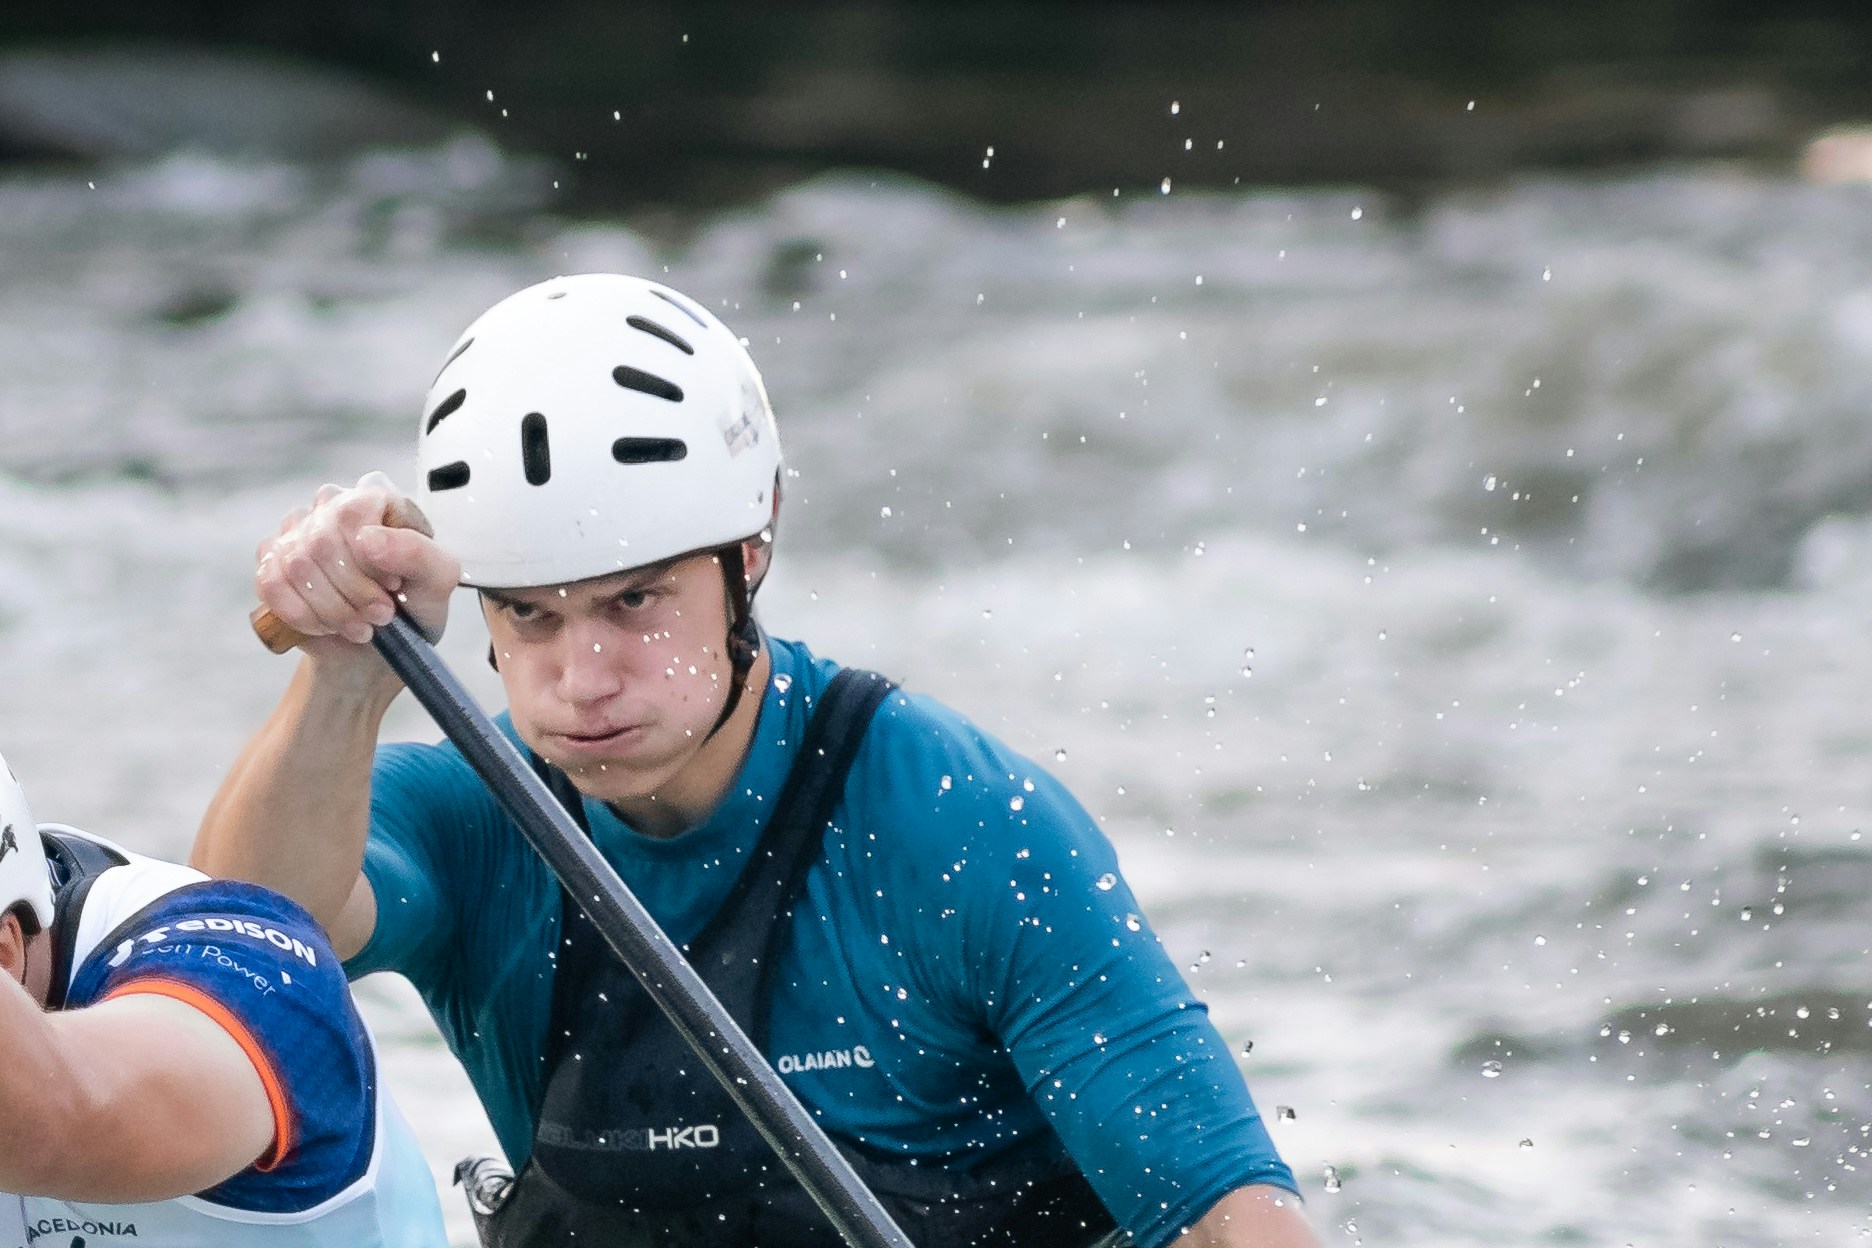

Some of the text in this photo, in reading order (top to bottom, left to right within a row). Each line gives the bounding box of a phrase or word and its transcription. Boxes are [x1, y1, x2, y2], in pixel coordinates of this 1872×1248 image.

[201, 945, 276, 997] Power
[778, 1049, 852, 1074] OLAIAN
[648, 1125, 719, 1150] HKO
[26, 1218, 138, 1244] ACEDONIA
